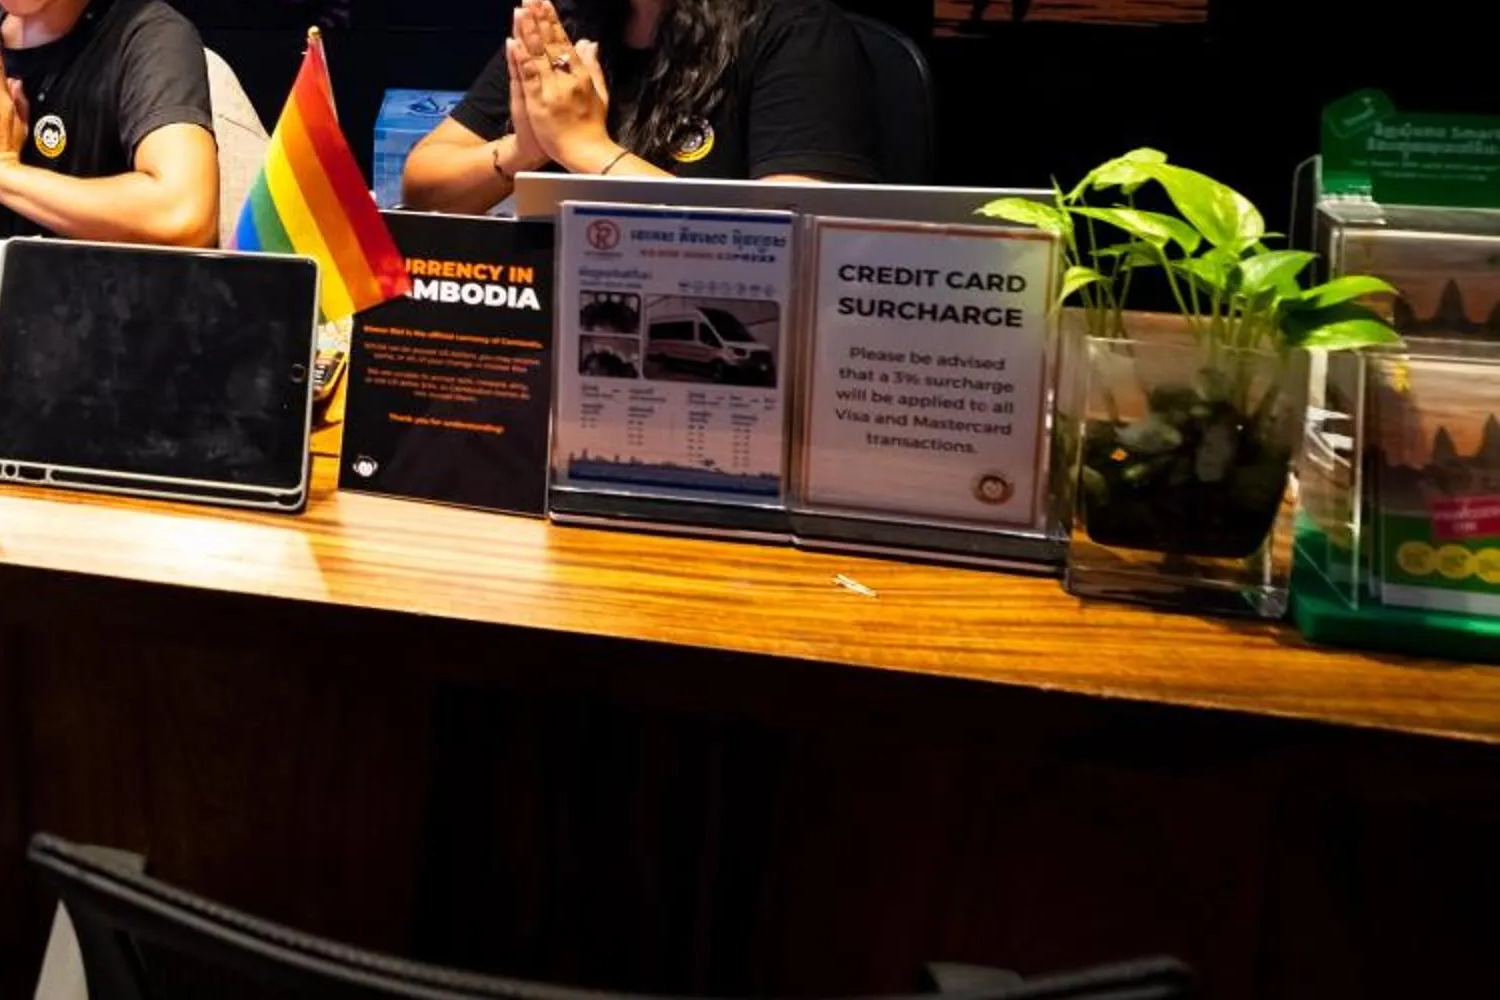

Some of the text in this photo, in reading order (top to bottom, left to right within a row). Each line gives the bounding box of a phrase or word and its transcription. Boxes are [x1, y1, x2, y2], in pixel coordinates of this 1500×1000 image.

[406, 258, 534, 284] RRENCY IN
[837, 264, 1028, 293] CREDIT CARD
[406, 278, 542, 311] MBODIA
[837, 297, 1025, 328] SURCHARGE
[850, 346, 1007, 371] Please be advised
[838, 367, 1015, 395] that a 3% surcharge
[835, 387, 1014, 415] will be applied to all
[835, 407, 1012, 436] Visa and Mastercard
[866, 432, 978, 454] transactions.
